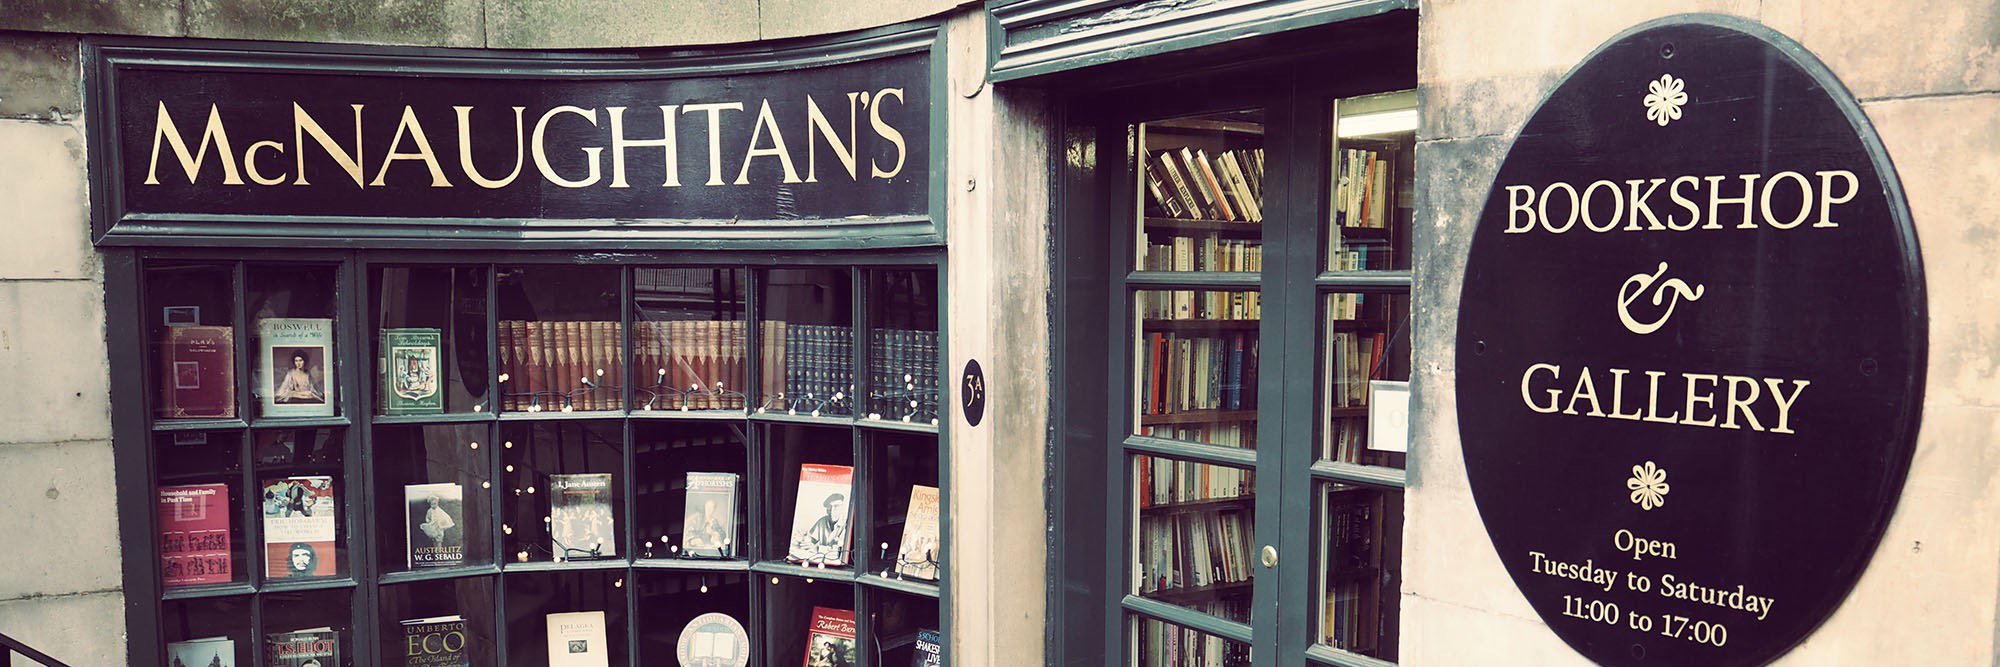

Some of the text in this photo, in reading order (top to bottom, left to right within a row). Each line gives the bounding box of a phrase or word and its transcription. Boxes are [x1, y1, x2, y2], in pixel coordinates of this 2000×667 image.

[1504, 170, 1859, 233] BOOKSHOP
[1617, 261, 1704, 334] &
[273, 323, 322, 331] BOSWELL
[1521, 363, 1810, 433] GALLERY
[562, 481, 580, 489] Jane
[415, 546, 461, 554] AUSTERLITZ
[1614, 529, 1676, 560] Open
[435, 553, 463, 561] SEBALD
[1529, 551, 1774, 620] Tuesday to Saturday
[407, 623, 464, 634] UMBERTO
[817, 620, 841, 631] Robert
[1562, 595, 1727, 647] 11:00 to 17:00
[297, 640, 333, 653] ELIOT
[407, 631, 465, 656] ECO
